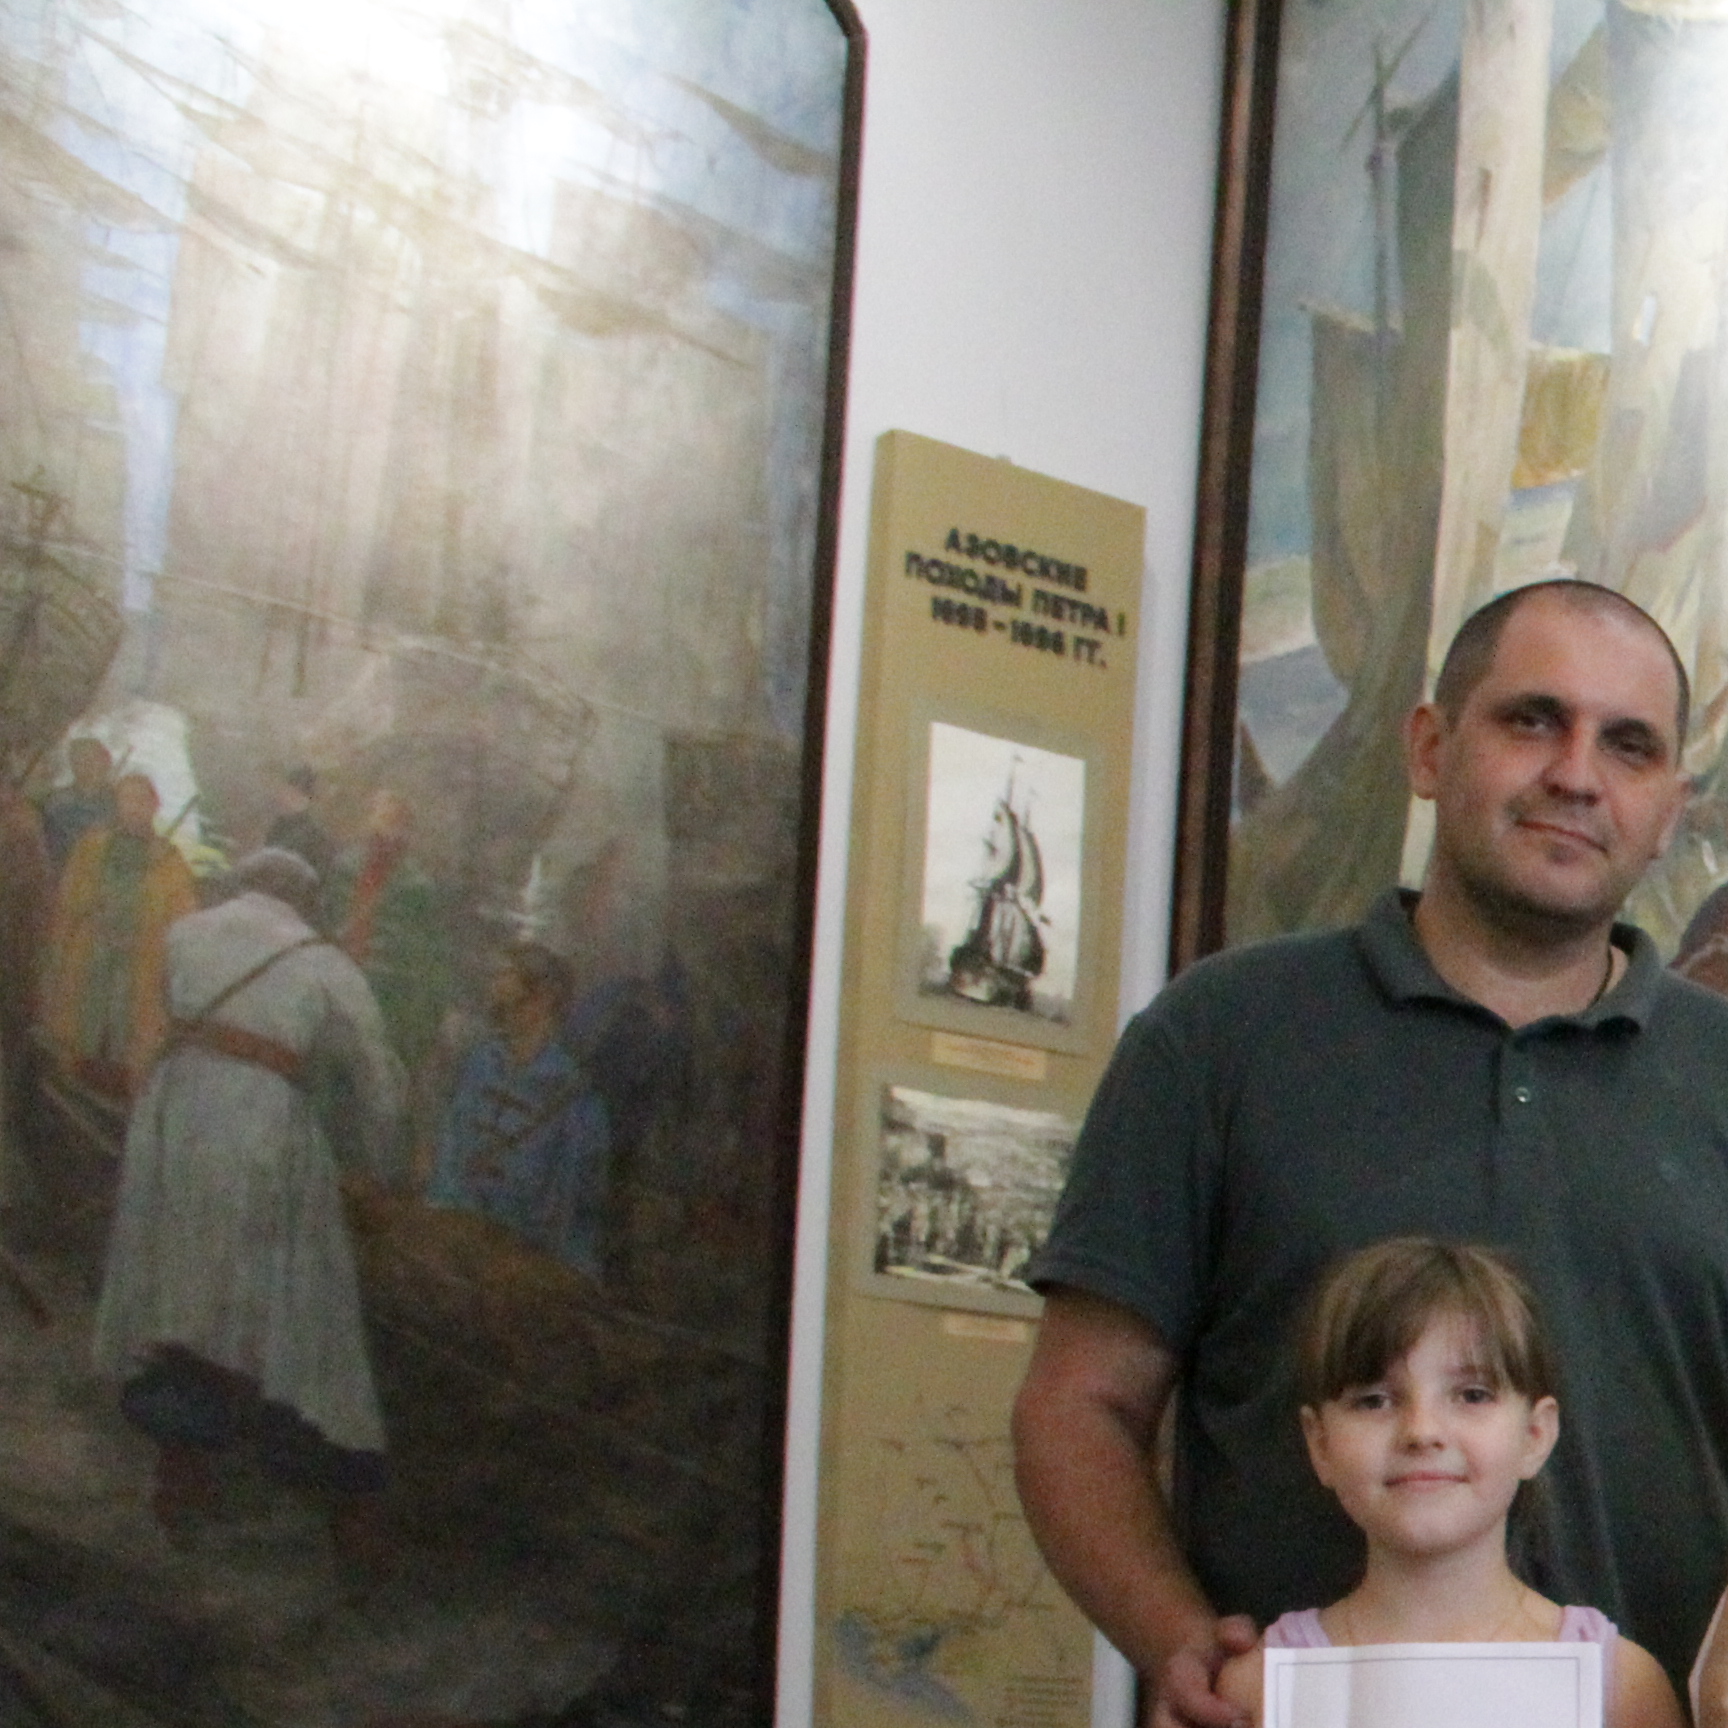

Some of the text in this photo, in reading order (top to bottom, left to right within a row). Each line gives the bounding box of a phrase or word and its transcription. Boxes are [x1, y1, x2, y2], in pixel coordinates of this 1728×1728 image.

[905, 552, 1022, 607] ПОХОДЫ
[1031, 588, 1110, 633] ПЕТРА
[946, 528, 1087, 592] АЗОВСКИЕ
